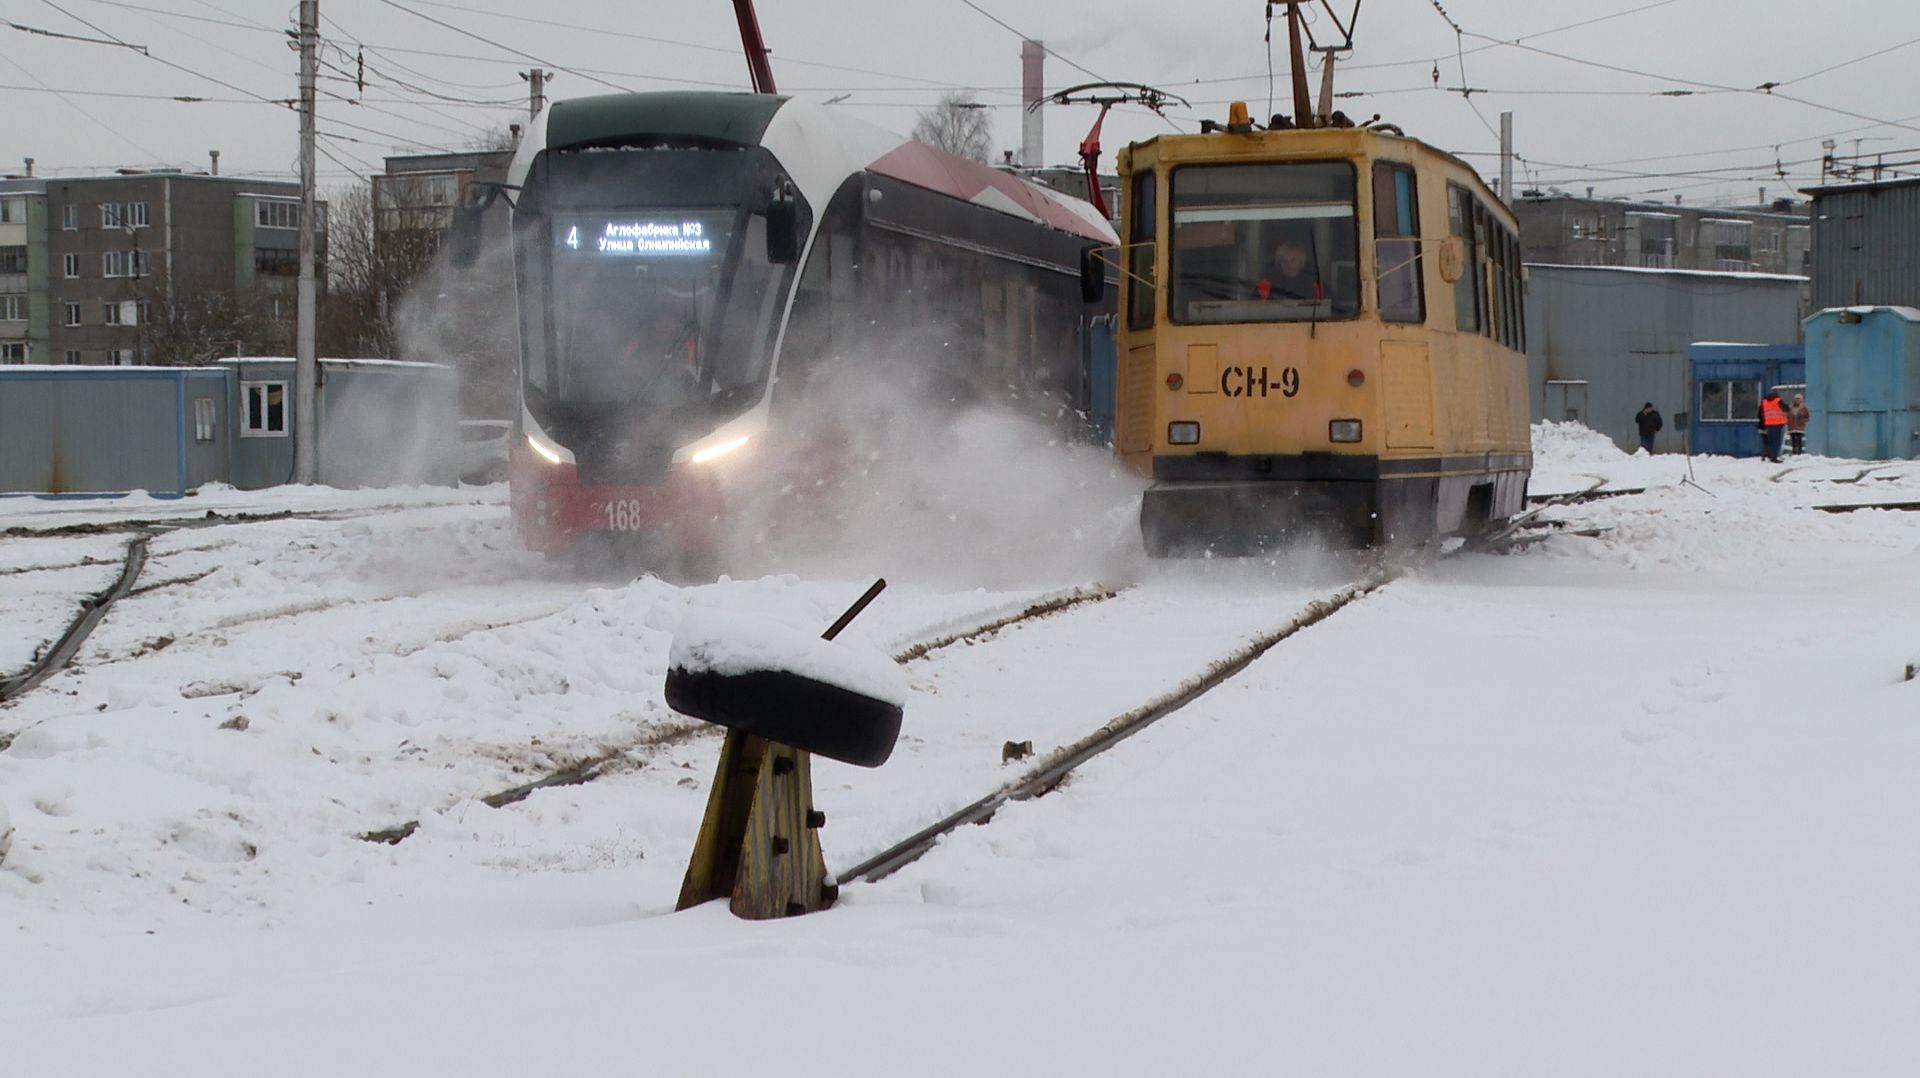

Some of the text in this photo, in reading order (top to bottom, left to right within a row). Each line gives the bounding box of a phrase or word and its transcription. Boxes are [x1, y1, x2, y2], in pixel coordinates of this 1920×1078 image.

[566, 225, 579, 249] 4
[605, 222, 679, 237] Аглофабрика
[600, 238, 710, 251] Улица Олимпийская
[1221, 366, 1299, 397] СН-9
[605, 499, 640, 531] 168
